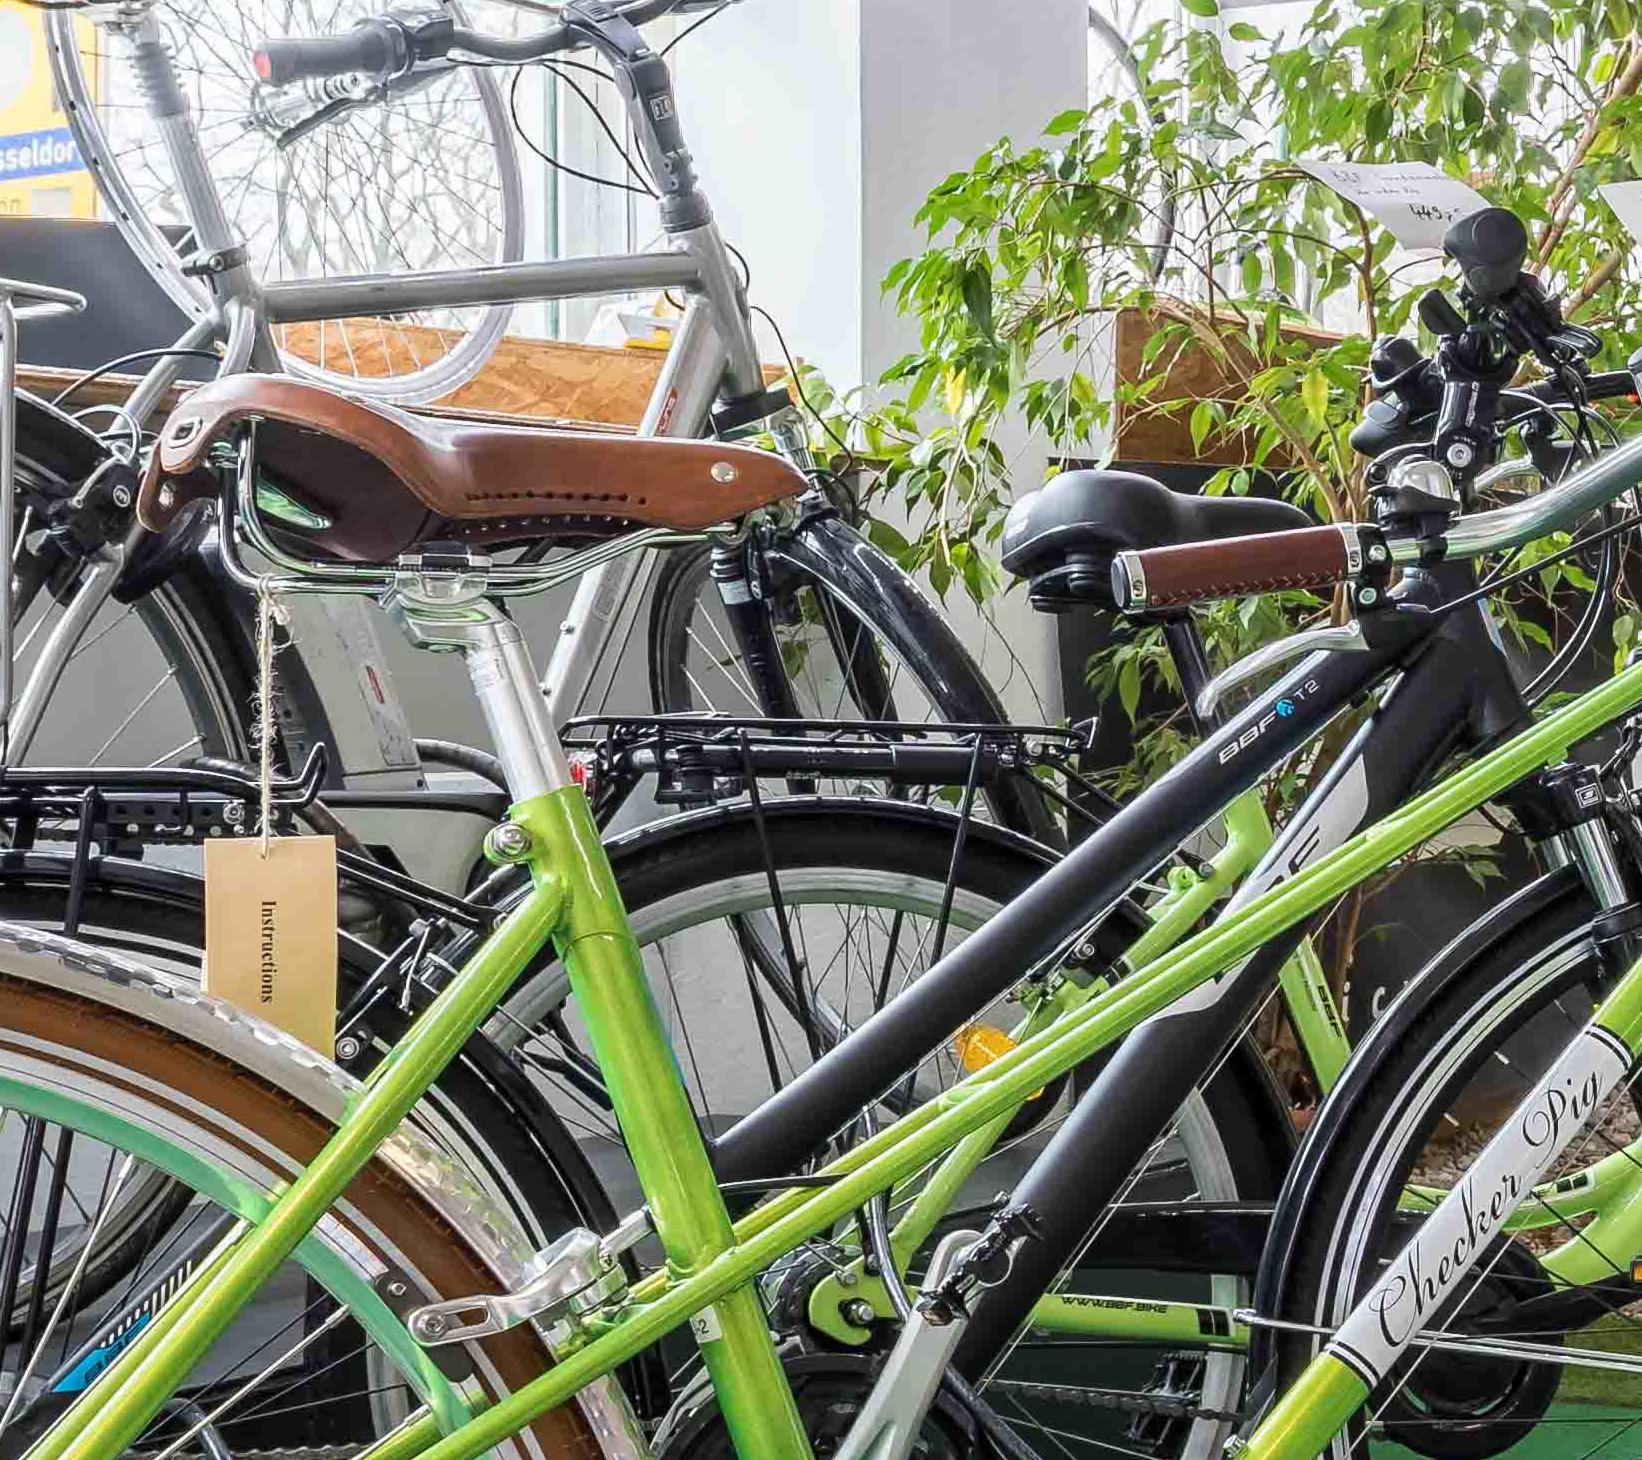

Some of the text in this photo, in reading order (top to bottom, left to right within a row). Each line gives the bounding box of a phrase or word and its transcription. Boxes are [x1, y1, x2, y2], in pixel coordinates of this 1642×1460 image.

[1218, 711, 1276, 766] BBF
[260, 900, 279, 1005] Instructions
[1368, 1070, 1604, 1347] Checker Pig
